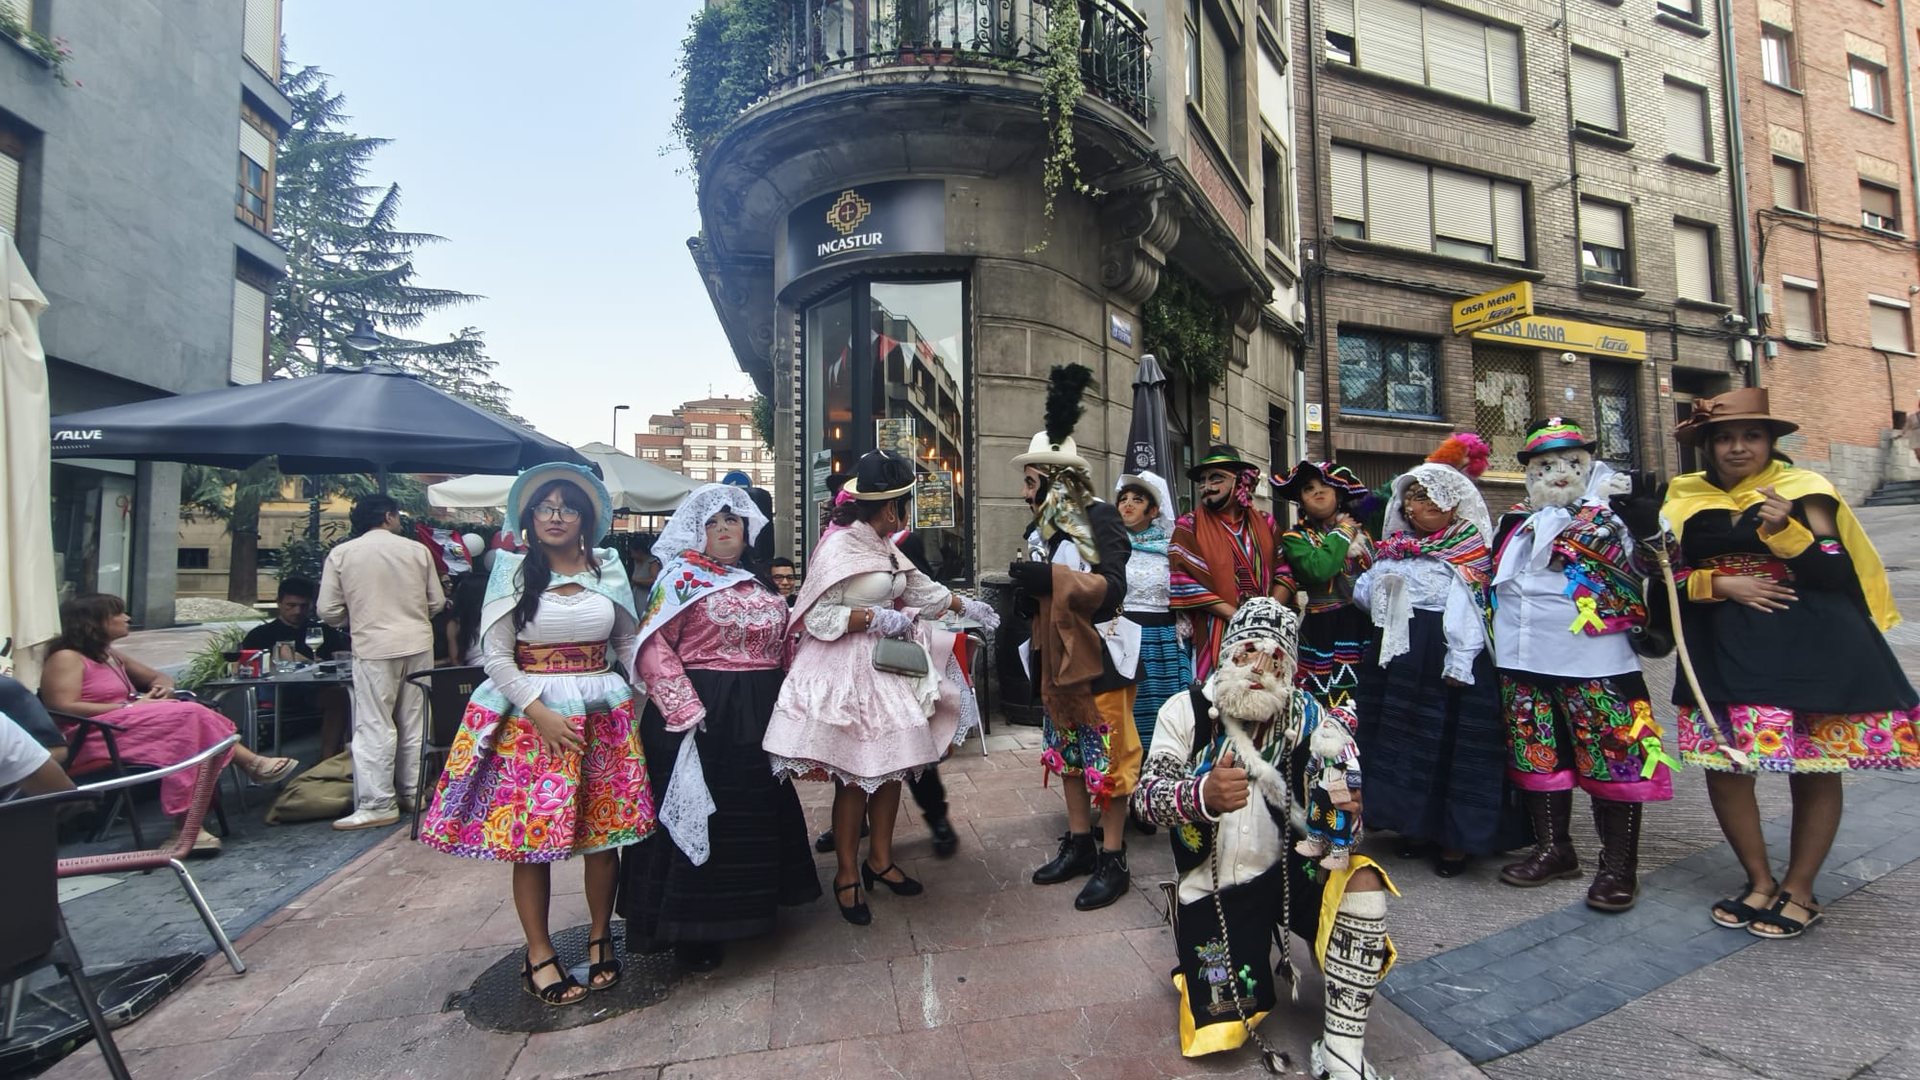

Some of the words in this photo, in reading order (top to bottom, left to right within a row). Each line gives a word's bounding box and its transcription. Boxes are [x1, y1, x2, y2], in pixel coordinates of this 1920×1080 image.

[817, 232, 883, 257] INCASTUR
[1461, 303, 1485, 316] CASA
[1487, 292, 1516, 309] MENA
[1526, 322, 1566, 343] MENA
